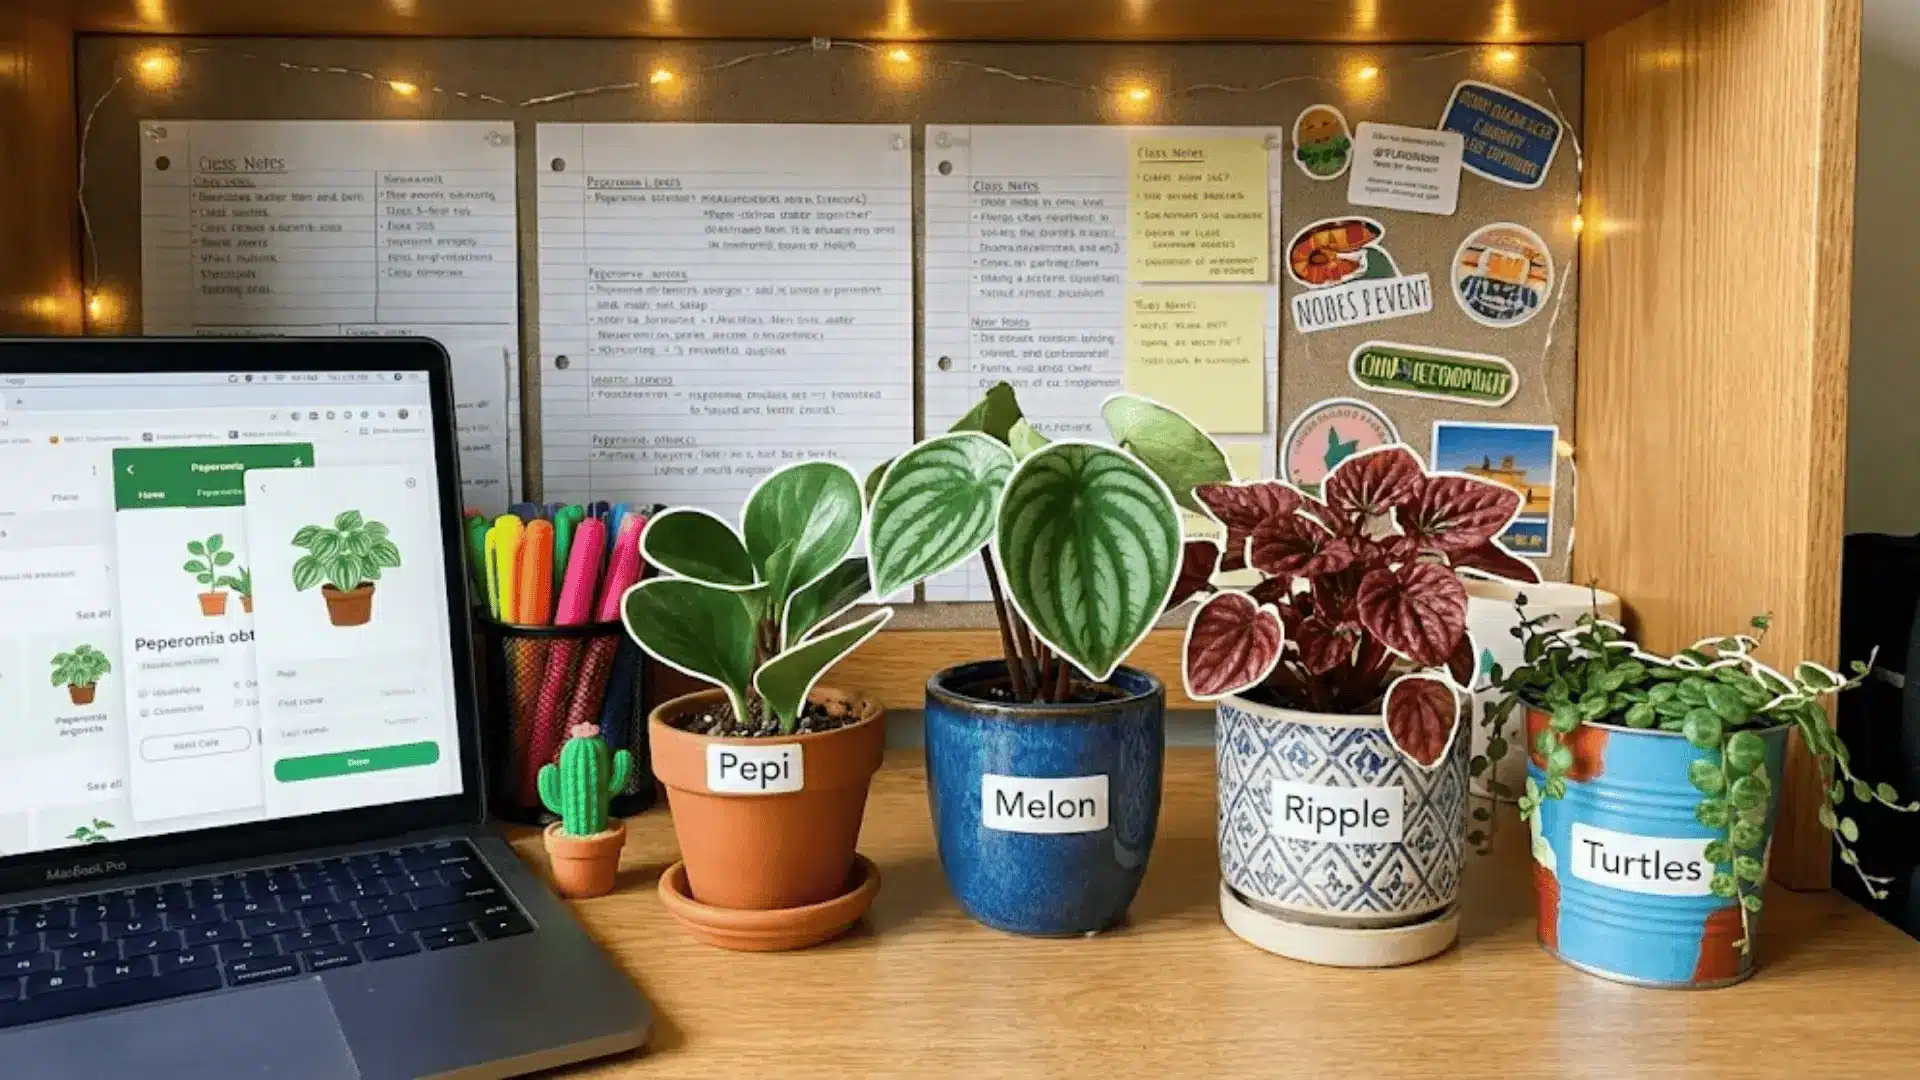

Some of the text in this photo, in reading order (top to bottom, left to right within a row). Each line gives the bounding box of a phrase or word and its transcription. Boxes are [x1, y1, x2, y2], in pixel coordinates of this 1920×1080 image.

[135, 632, 225, 652] Peperomia
[720, 753, 789, 789] Pepi
[996, 788, 1096, 819] Melon
[1286, 793, 1390, 837] Ripple
[1583, 839, 1702, 881] Turtles
